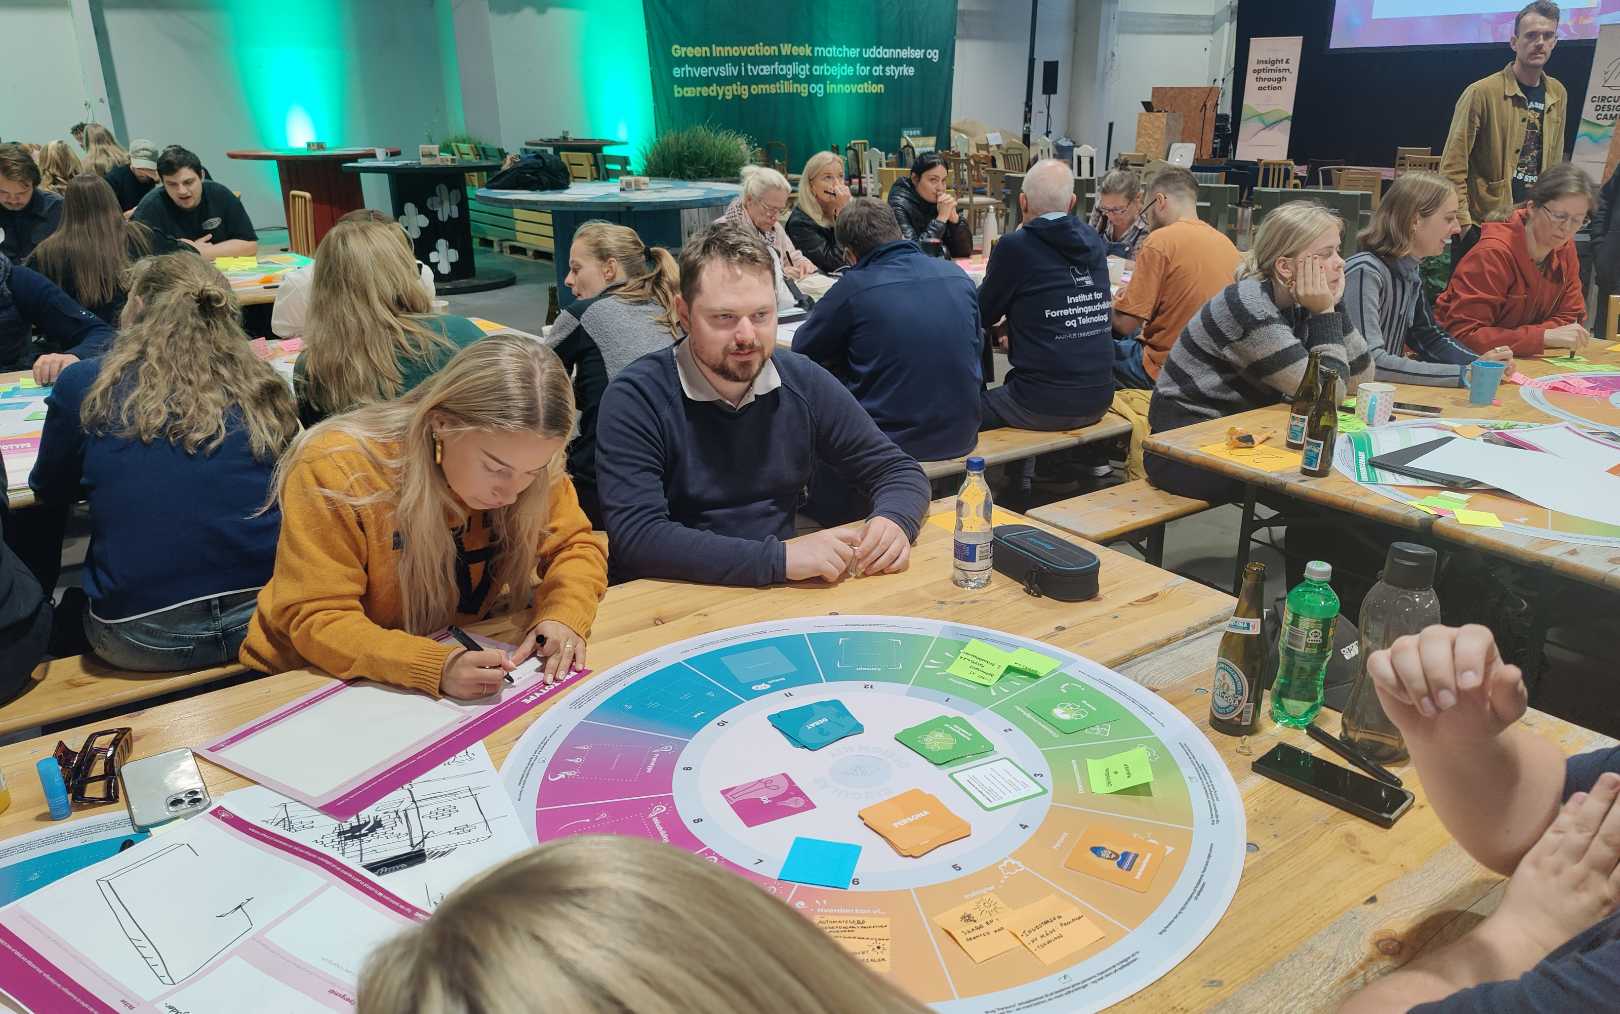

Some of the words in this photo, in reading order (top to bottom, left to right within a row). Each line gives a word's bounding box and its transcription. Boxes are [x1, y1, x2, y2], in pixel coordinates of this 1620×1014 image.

[671, 44, 710, 57] Green
[712, 43, 778, 56] Innovation
[780, 43, 812, 56] Week
[814, 45, 860, 57] matcher
[862, 46, 925, 59] uddannelser
[926, 49, 940, 62] og
[1257, 58, 1284, 66] Insight
[672, 63, 739, 78] erhvervsliv
[741, 62, 745, 76] i
[747, 61, 810, 78] tværfagligt
[812, 63, 854, 79] arbejde
[856, 64, 871, 76] for
[872, 65, 883, 76] at
[884, 64, 915, 80] styrke
[1252, 67, 1292, 75] optimism,
[673, 82, 749, 100] bæredygtig
[750, 80, 809, 97] omstilling
[809, 83, 824, 97] og
[826, 81, 885, 94] innovation
[1067, 294, 1093, 304] Institut
[1094, 291, 1103, 300] for
[951, 863, 962, 871] 5
